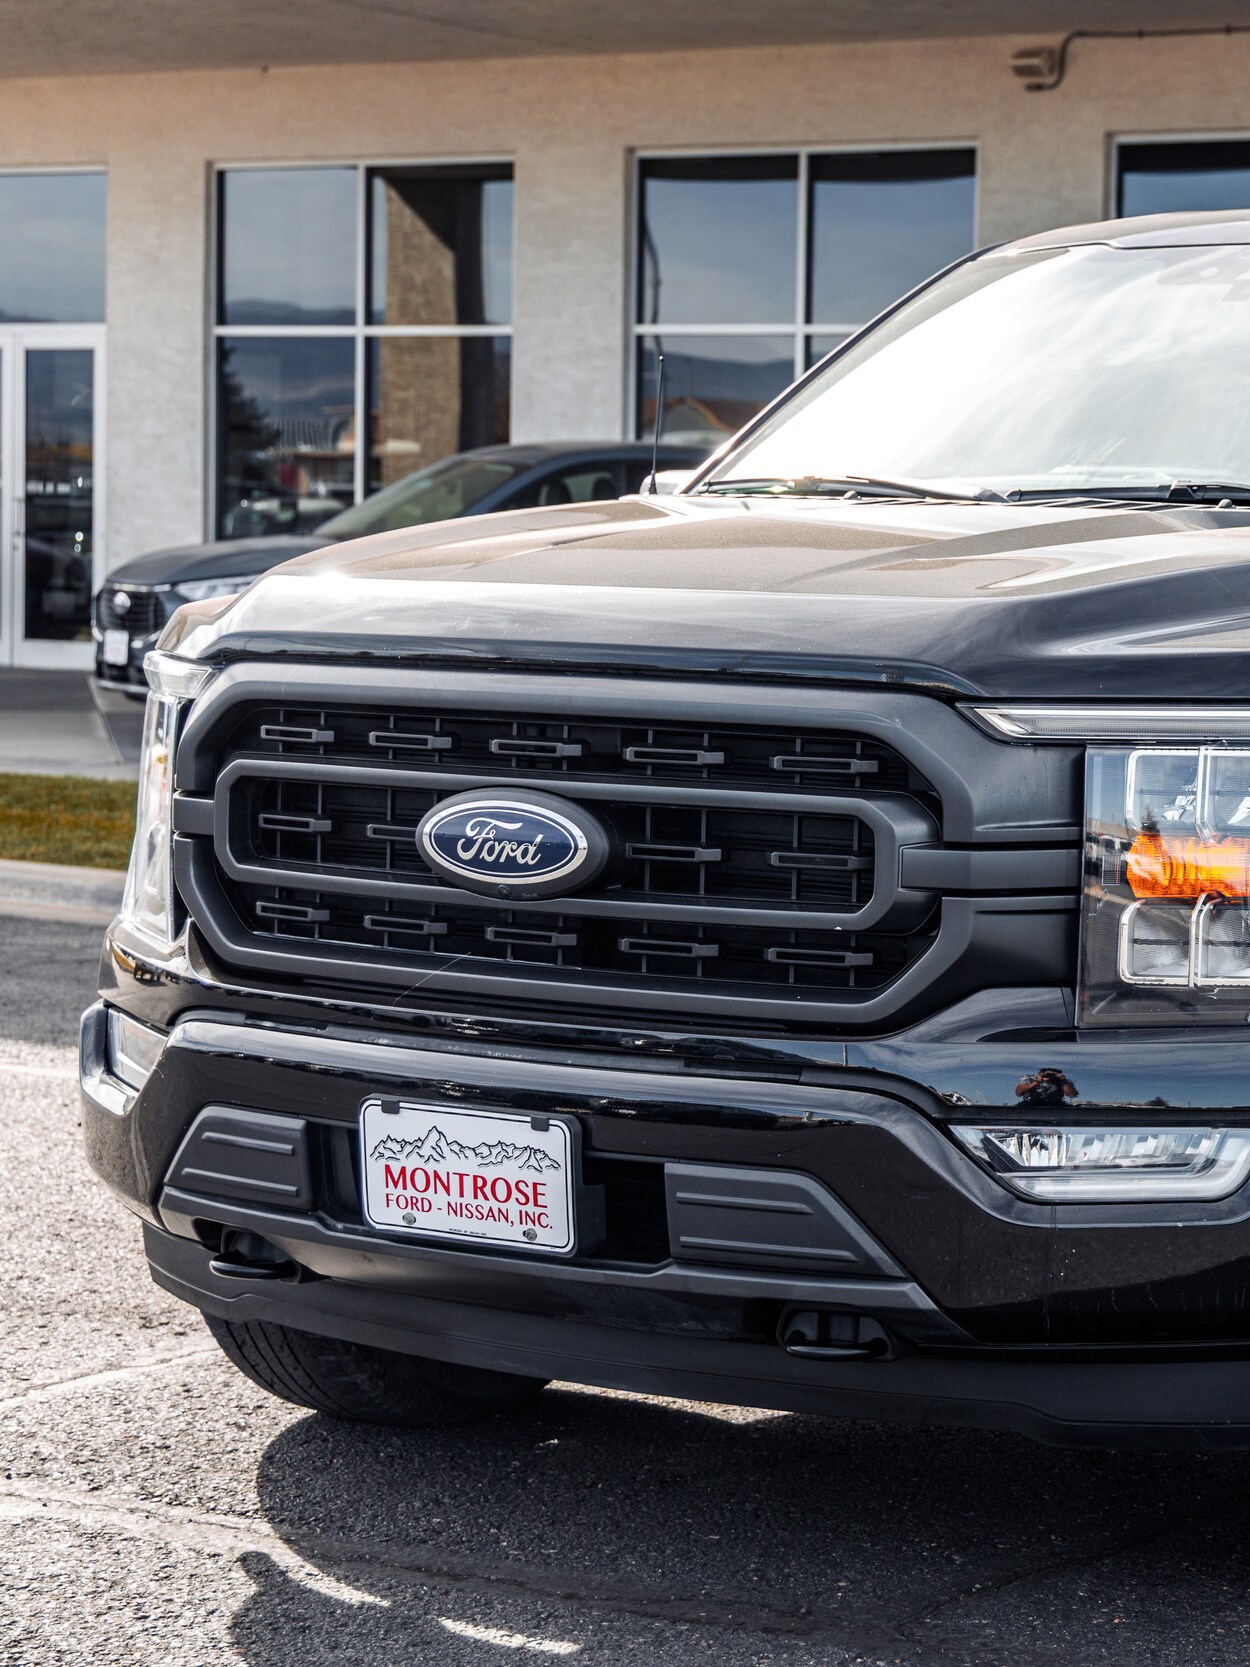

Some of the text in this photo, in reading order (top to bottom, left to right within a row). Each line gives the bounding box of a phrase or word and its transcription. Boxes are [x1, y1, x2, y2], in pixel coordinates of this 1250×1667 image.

[457, 817, 544, 865] Ford
[384, 1164, 548, 1209] MONTROSE
[385, 1193, 433, 1213] FORD
[447, 1201, 515, 1227] NISSAN,
[519, 1209, 553, 1229] INC.
